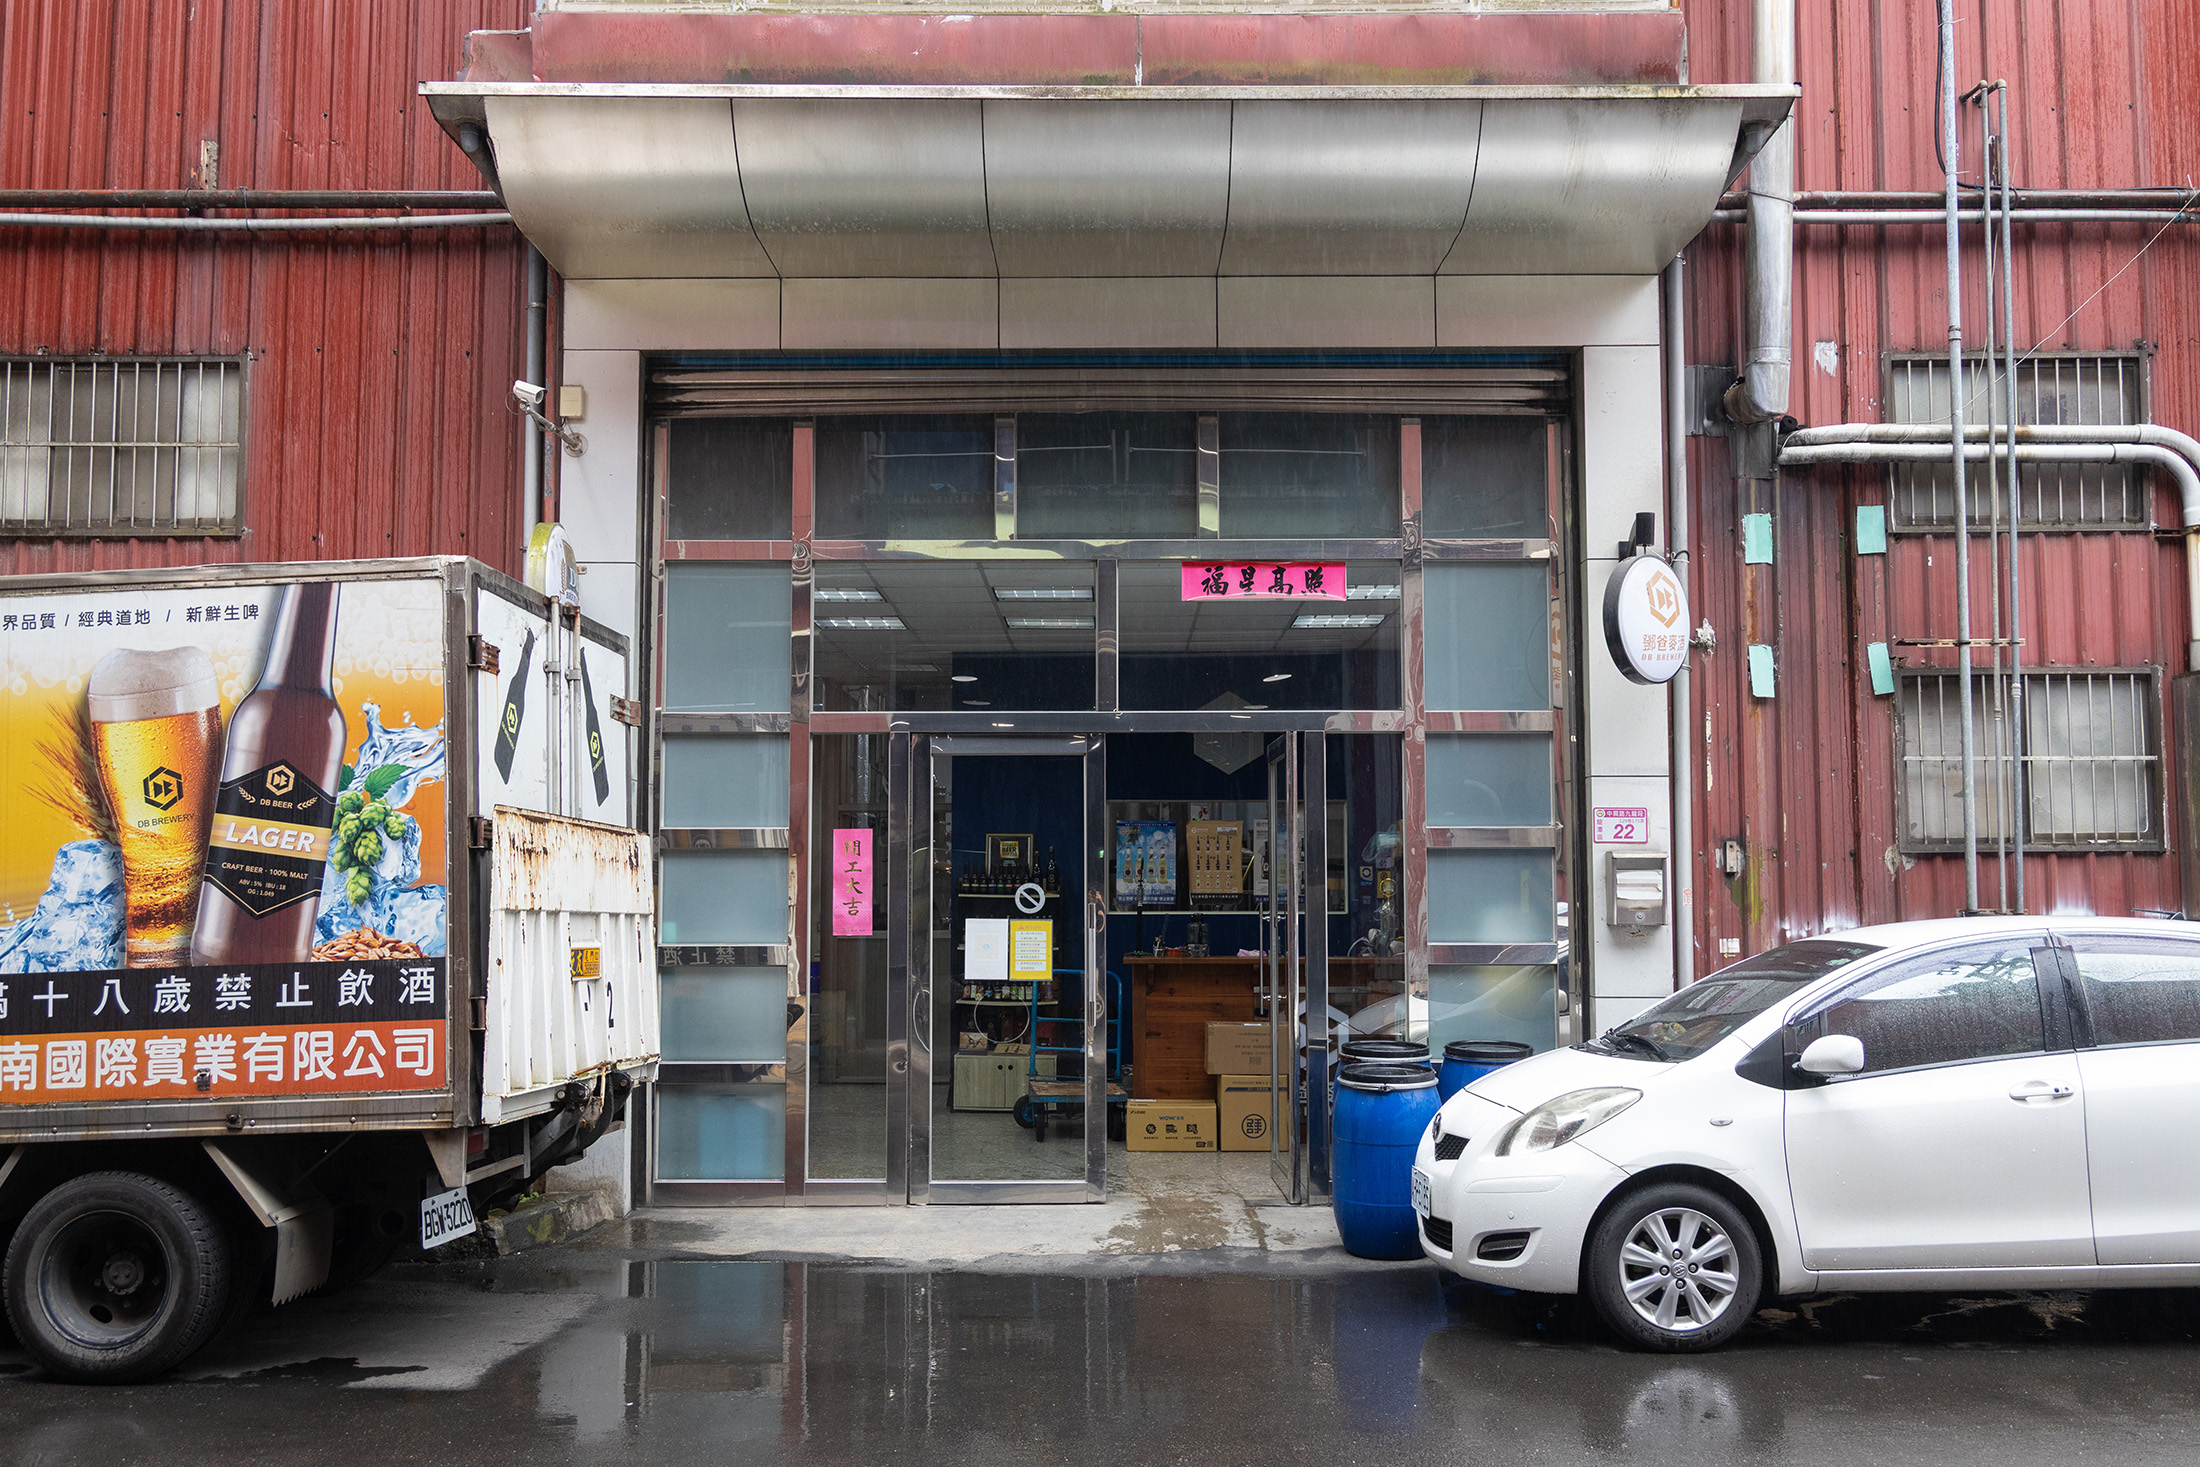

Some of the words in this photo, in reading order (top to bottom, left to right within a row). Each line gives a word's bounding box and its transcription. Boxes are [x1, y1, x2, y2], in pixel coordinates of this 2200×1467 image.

[1201, 565, 1327, 596] 福星高照
[2, 612, 56, 631] 界品質
[78, 608, 151, 627] 經典道地
[185, 603, 260, 623] 新鮮生啤
[260, 798, 271, 806] DB
[272, 800, 293, 809] BEER
[138, 820, 150, 828] DB
[152, 813, 194, 827] BREWERY
[1613, 824, 1635, 839] 22
[225, 822, 315, 853] LAGER
[221, 862, 244, 871] CRAFT
[245, 865, 263, 874] BEER
[269, 868, 288, 877] 100%
[289, 871, 308, 880] MALT
[0, 1028, 434, 1091] 南國際實業有限公司
[424, 1198, 473, 1240] BGW-3220
